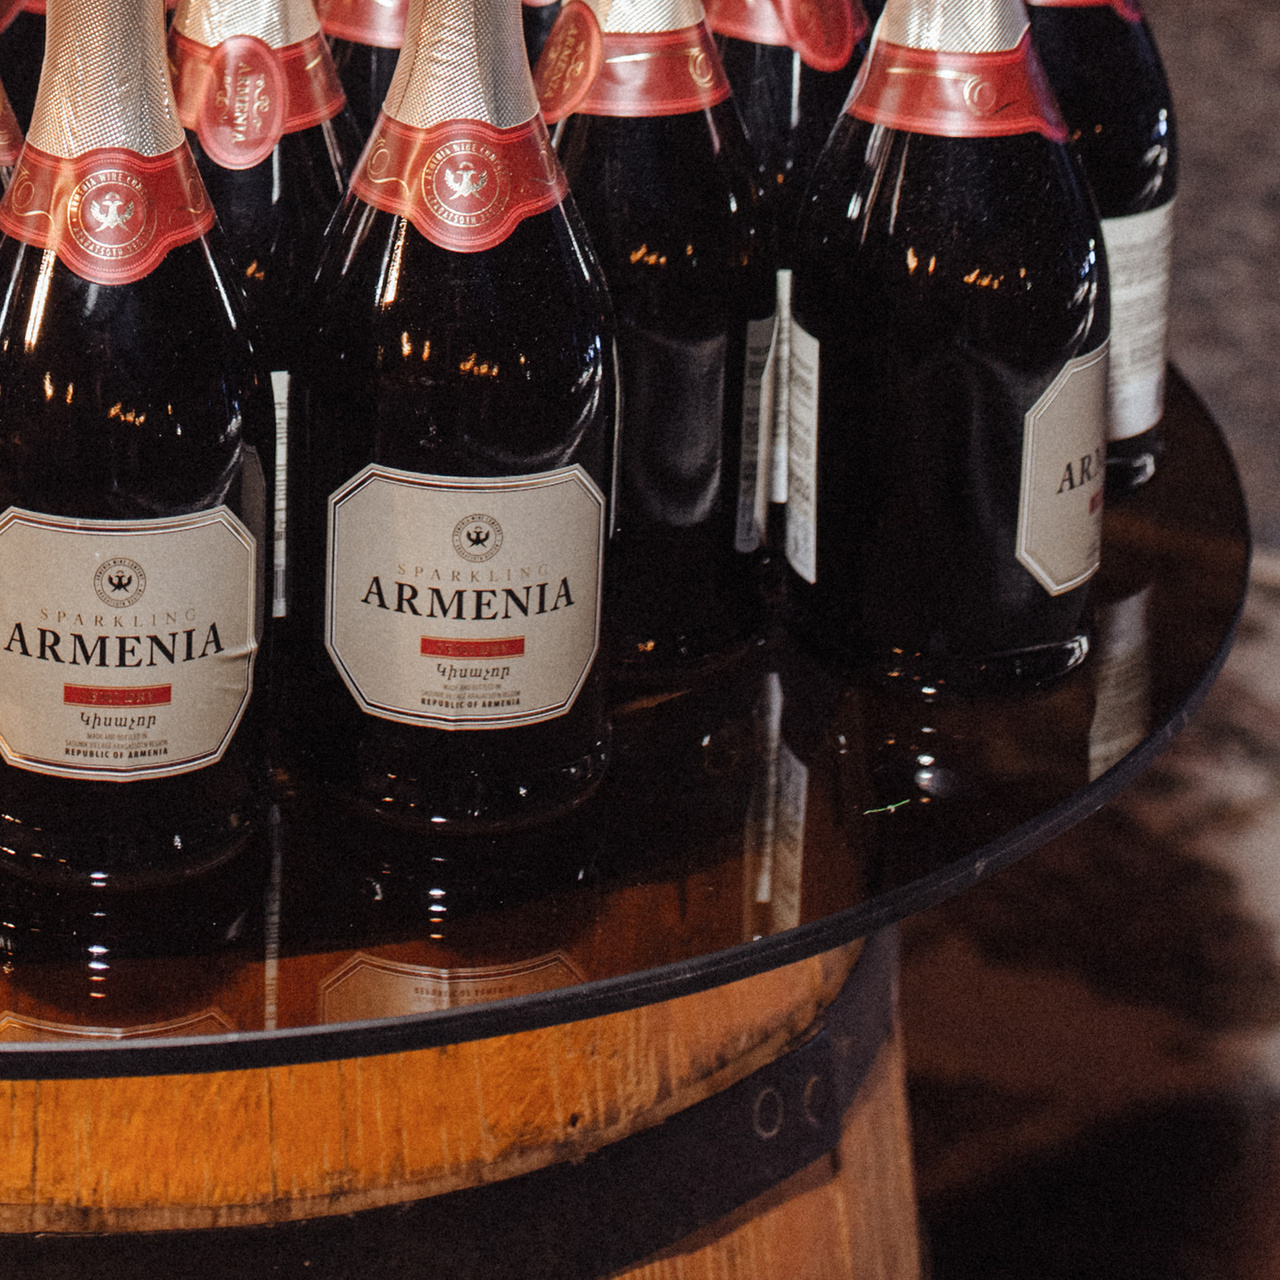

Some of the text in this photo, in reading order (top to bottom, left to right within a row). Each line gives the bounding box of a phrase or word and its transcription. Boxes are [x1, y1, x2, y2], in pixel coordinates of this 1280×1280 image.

[232, 62, 252, 143] ARMENIA
[98, 172, 123, 184] WINE
[398, 562, 550, 582] SPARKLING
[361, 576, 574, 620] ARMENIA
[39, 607, 196, 628] SPARKLING
[3, 622, 225, 668] ARMENIA
[436, 663, 510, 680] Կիսաչոր
[421, 698, 520, 708] REPUBLIC OF ARMENIA
[80, 712, 156, 730] Կիսաչոր
[64, 748, 109, 758] REPUBLIC
[128, 748, 168, 758] ARMENIA
